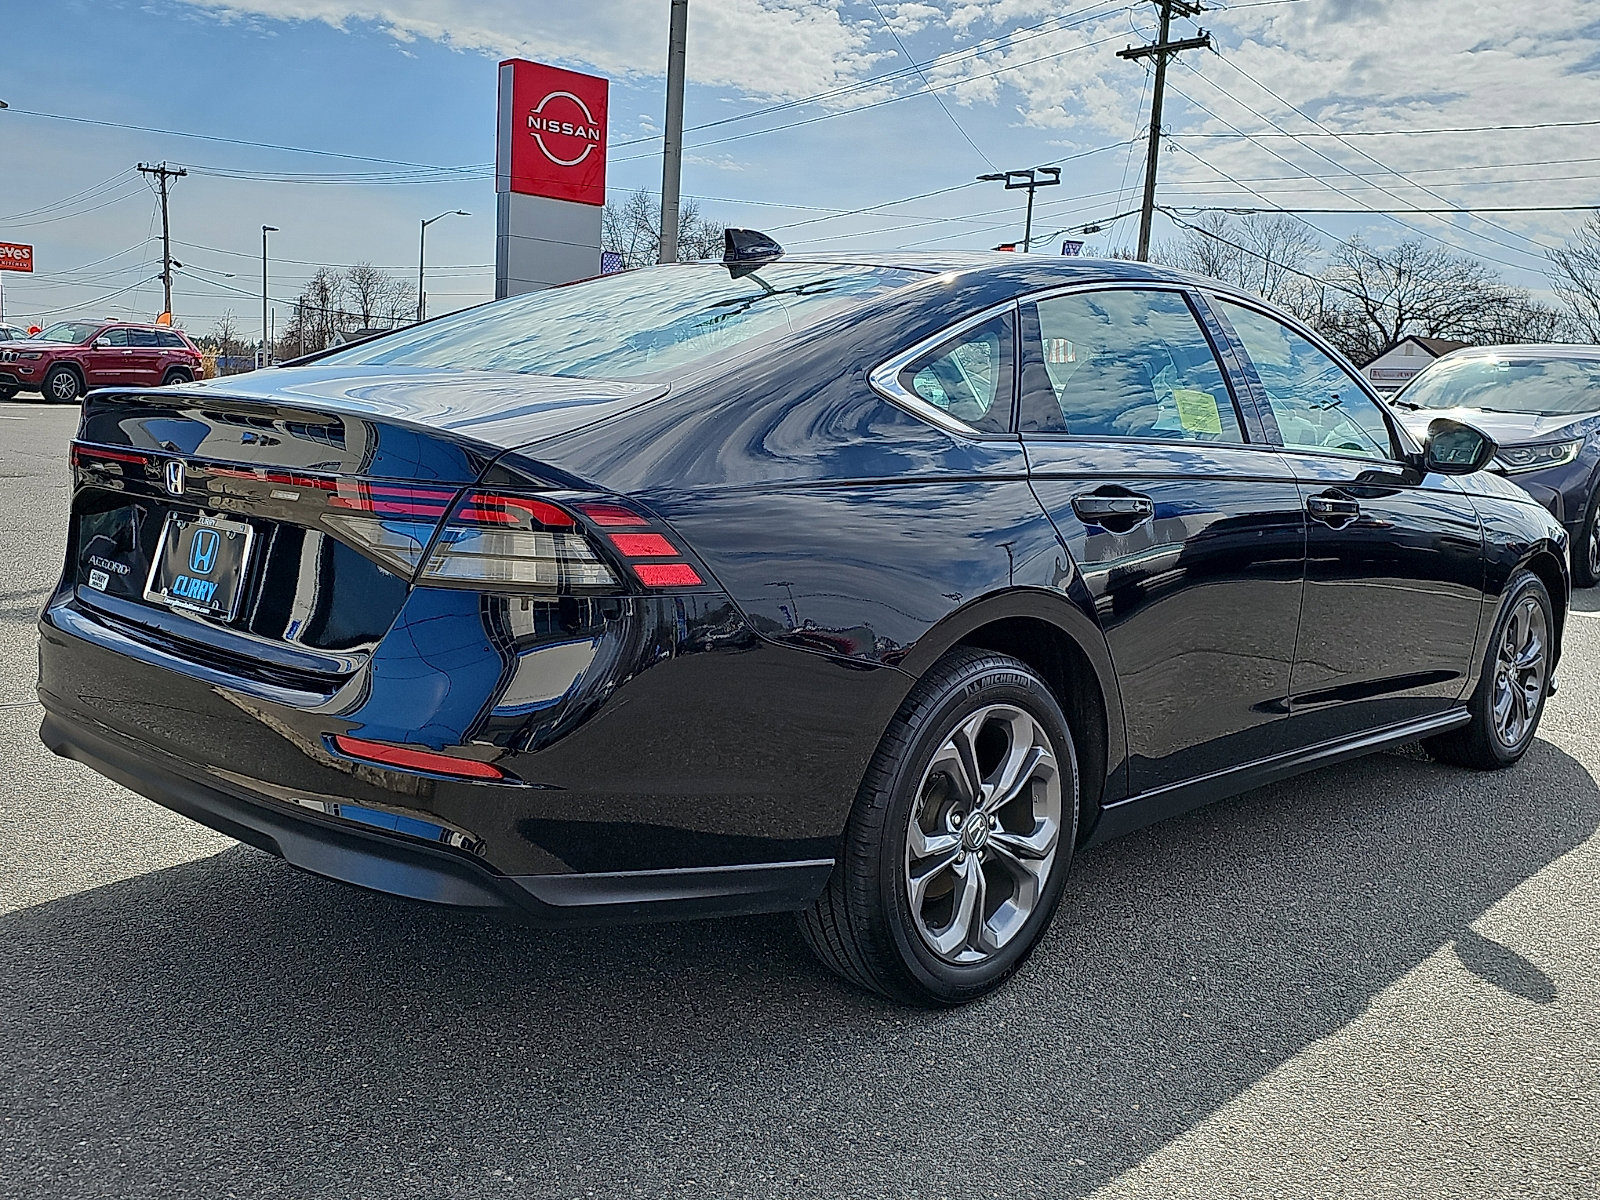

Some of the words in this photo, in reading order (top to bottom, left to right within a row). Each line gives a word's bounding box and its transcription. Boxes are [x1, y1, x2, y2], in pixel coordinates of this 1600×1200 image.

[528, 116, 600, 141] NISSAN
[173, 575, 218, 603] CURRY
[981, 673, 1028, 688] MICHELIN
